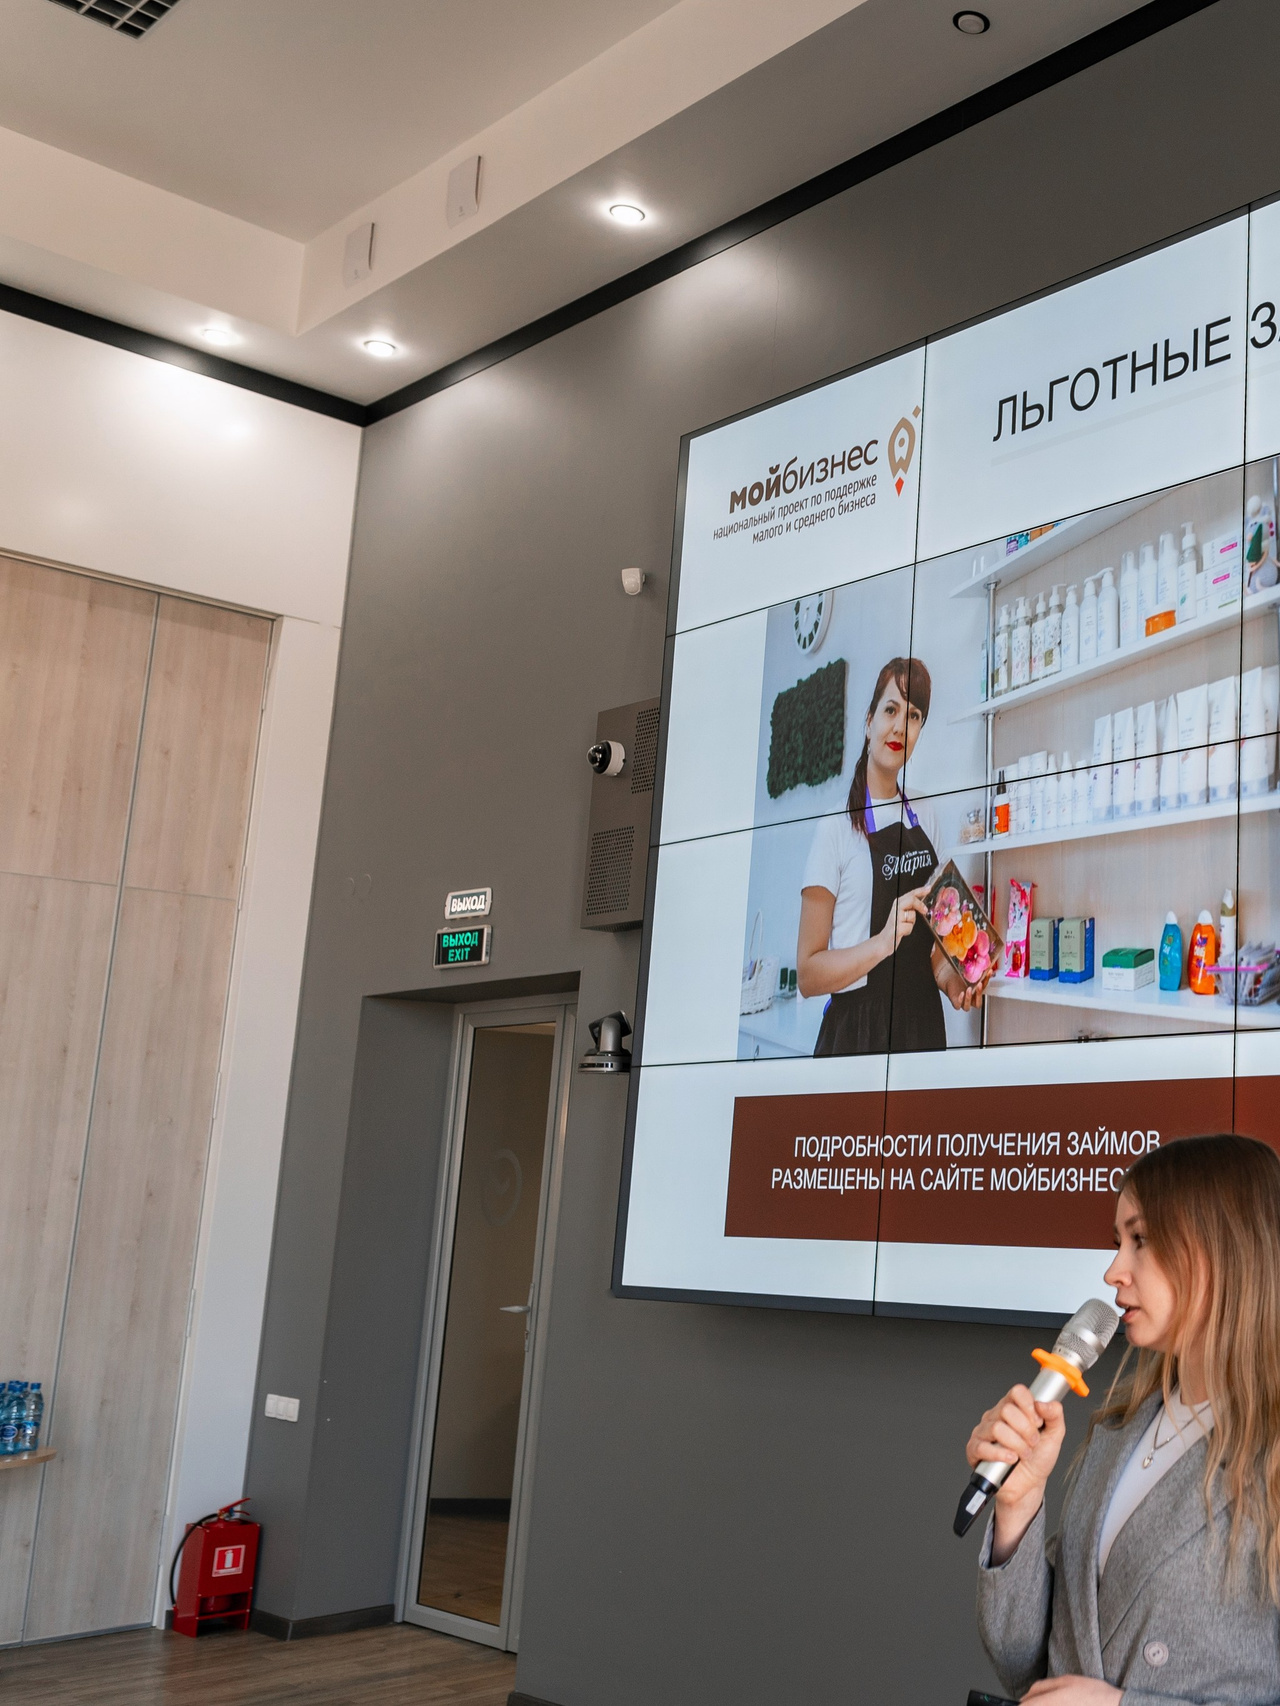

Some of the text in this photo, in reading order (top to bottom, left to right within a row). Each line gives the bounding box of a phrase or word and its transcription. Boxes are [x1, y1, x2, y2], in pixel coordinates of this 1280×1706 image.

[993, 315, 1232, 441] ЛЬГОТНЫЕ
[713, 473, 877, 540] национальный проект по поддержке
[752, 493, 876, 544] малого и среднего бизнеса
[882, 854, 932, 880] Мария
[451, 895, 485, 912] ВЫХОД
[442, 931, 478, 948] ВЫХОД
[448, 948, 470, 962] EXIT
[794, 1126, 1161, 1162] ПОДРОБНОСТИ ПОЛУЧЕНИЯ ЗАЙМОВ
[771, 1163, 1129, 1195] РАЗМЕЩЕНЫ НА САЙТЕ МОЙБИЗНЕС
